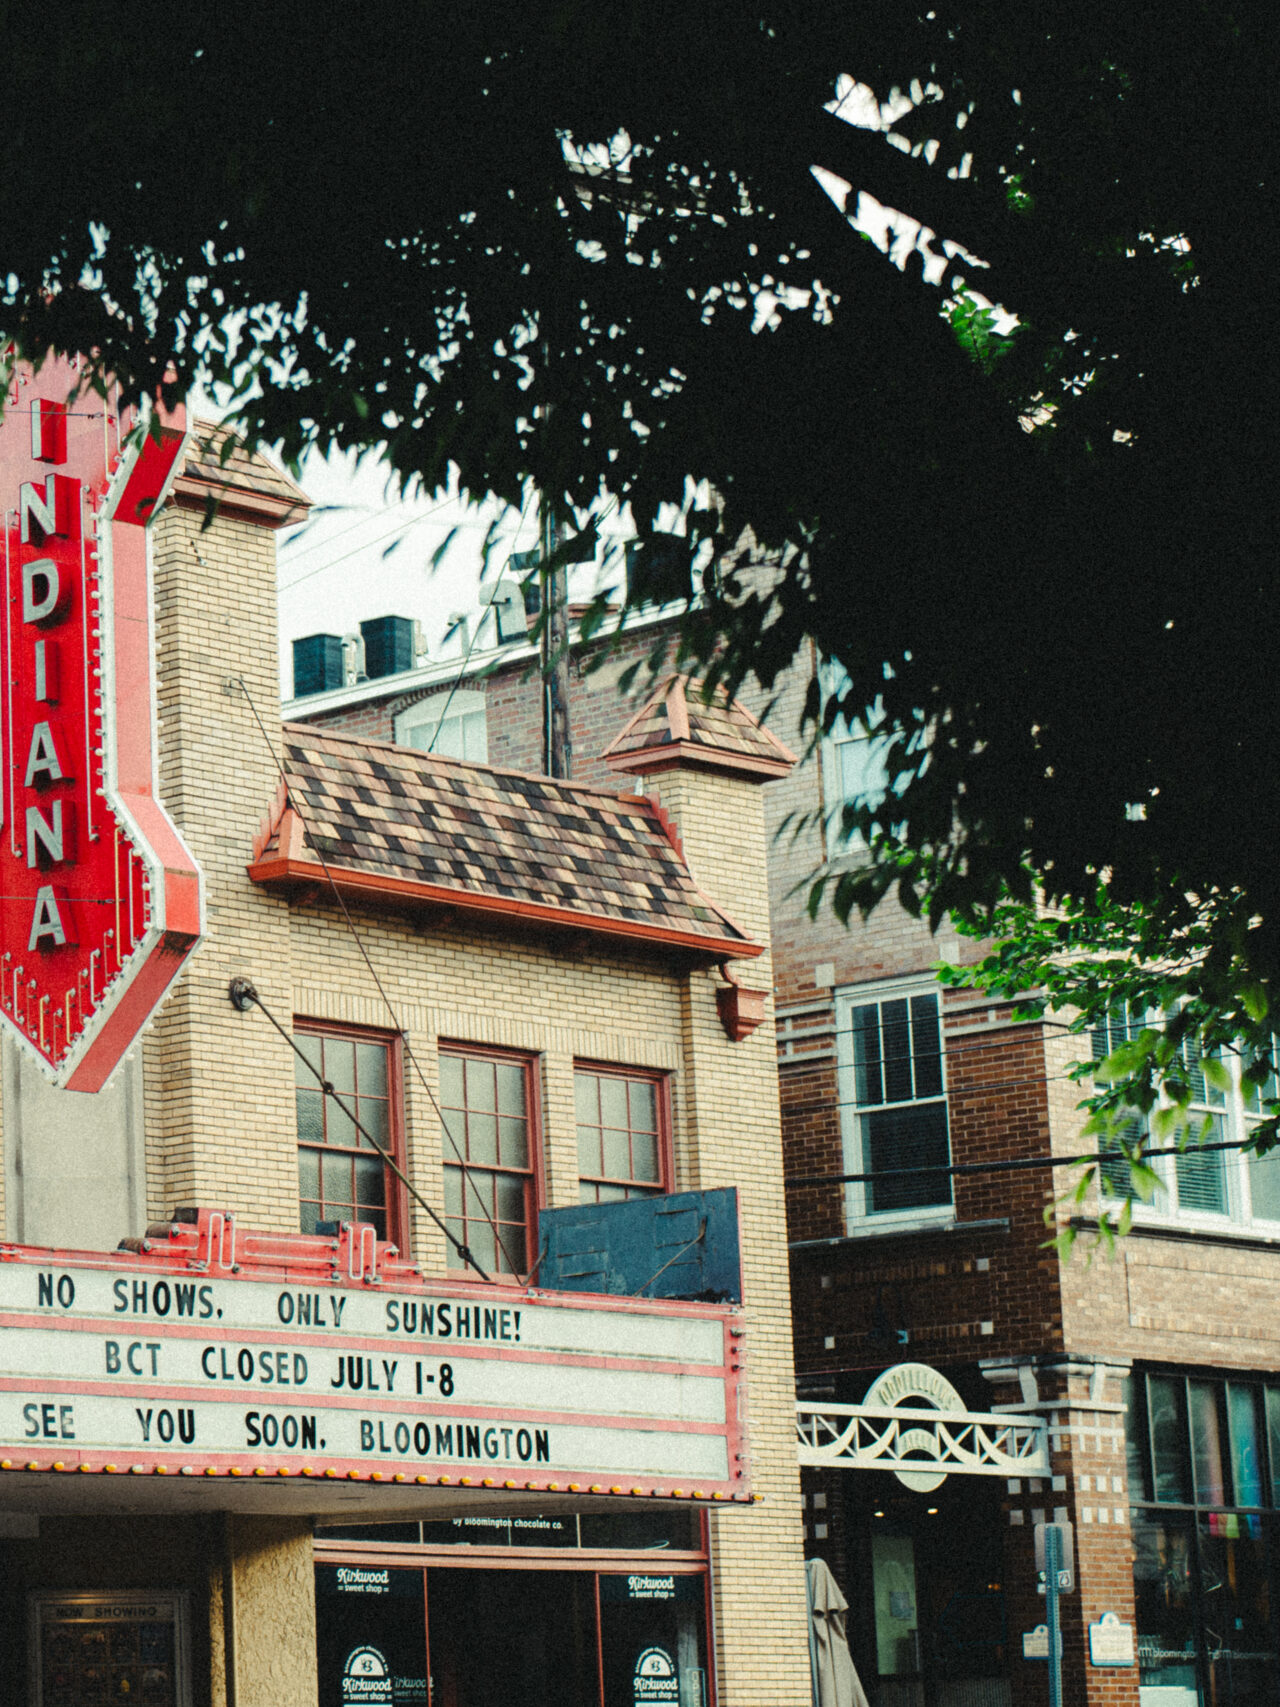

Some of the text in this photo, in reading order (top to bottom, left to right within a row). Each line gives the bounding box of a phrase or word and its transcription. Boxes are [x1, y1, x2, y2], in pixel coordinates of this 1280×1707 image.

[20, 397, 66, 953] INDIANA
[38, 1272, 75, 1308] NO
[277, 1291, 347, 1328] ONLY
[385, 1301, 522, 1341] SUNSHINE!
[105, 1340, 455, 1397] BCT CLOSED JULY 1-8
[23, 1403, 76, 1440] SEE
[135, 1408, 196, 1444] YOU
[360, 1419, 550, 1463] BLOOMINGTON
[464, 1517, 513, 1528] bloomington
[514, 1518, 551, 1529] chocolate
[337, 1568, 390, 1585] Kirkwood
[628, 1576, 675, 1591] Kirkwood
[344, 1584, 383, 1594] sweet shop
[342, 1677, 393, 1693] Kirkwood
[633, 1676, 679, 1692] Kirkwood
